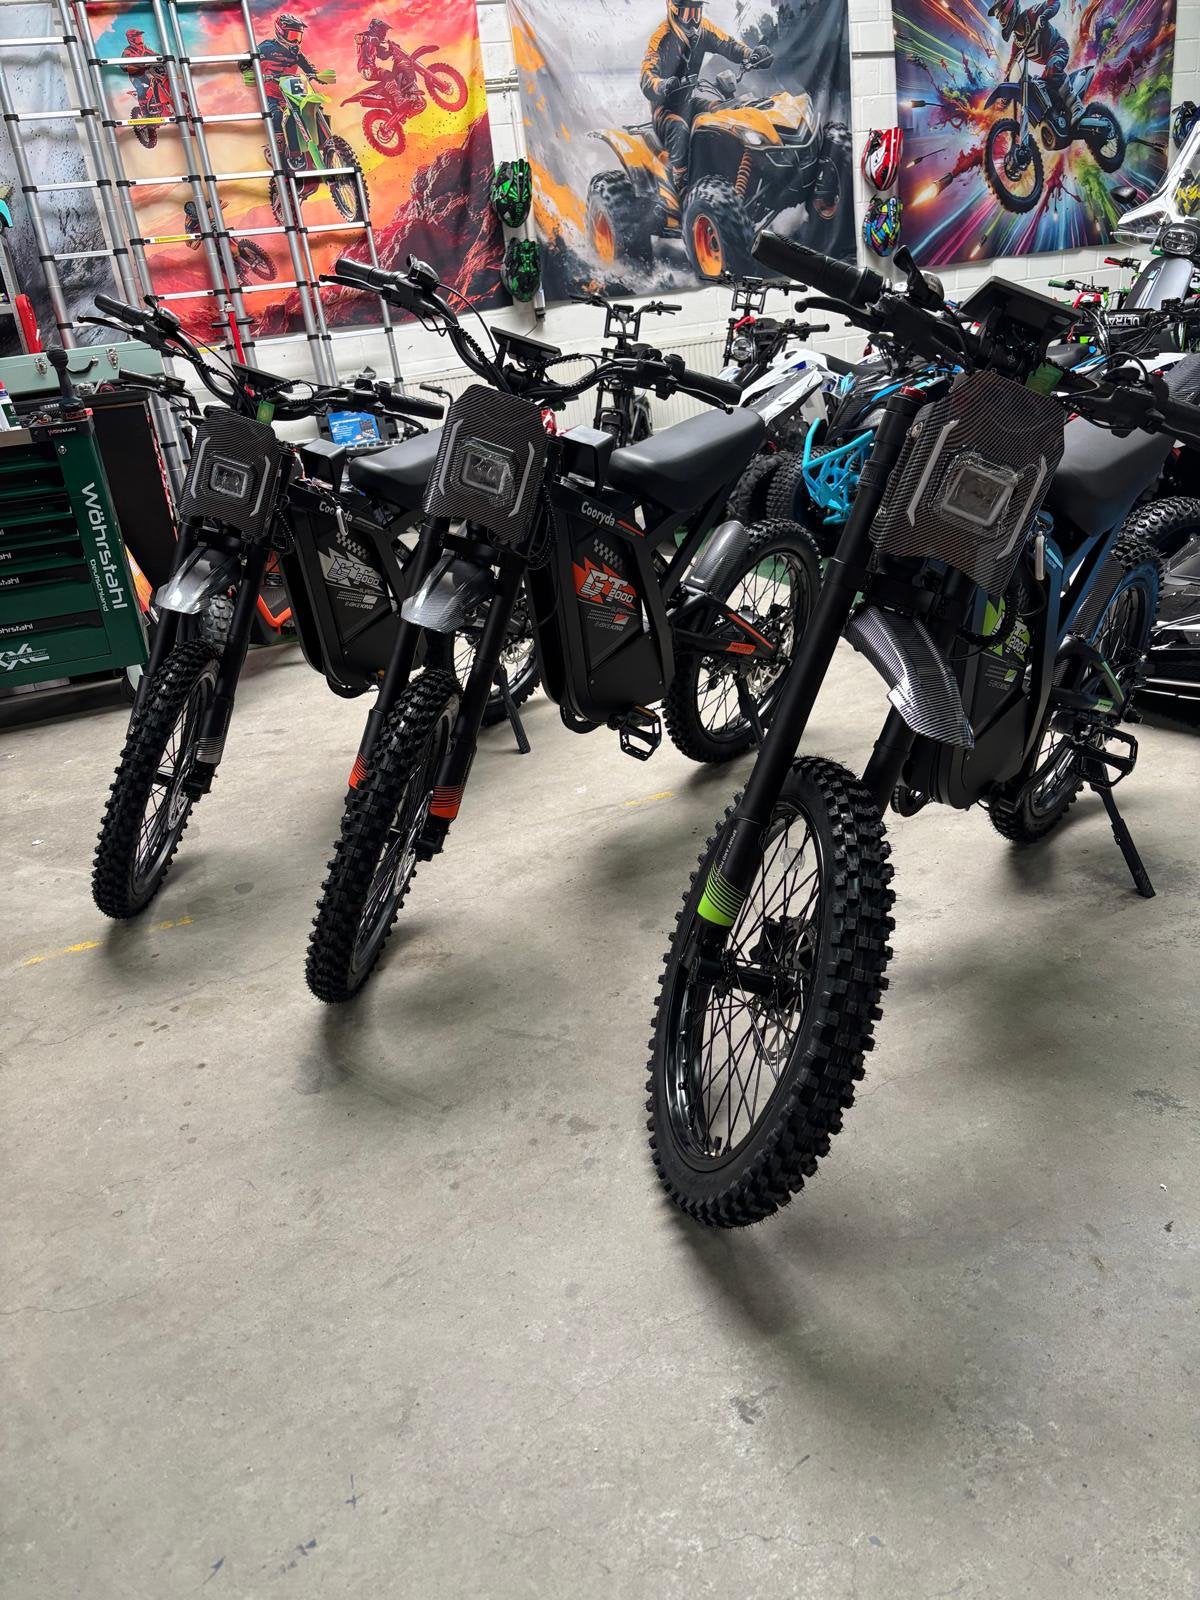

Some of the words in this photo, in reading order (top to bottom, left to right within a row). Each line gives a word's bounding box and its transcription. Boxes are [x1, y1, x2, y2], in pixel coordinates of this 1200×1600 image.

[1108, 316, 1140, 327] ULTRA
[319, 501, 353, 522] Cooda
[581, 501, 616, 526] Cooryda
[81, 482, 128, 609] Wöhrstahl
[89, 558, 109, 612] Deutschland
[354, 573, 380, 586] 2000
[580, 569, 629, 600] GT
[606, 587, 634, 603] 2000
[1006, 635, 1028, 655] 2000
[728, 830, 737, 848] SPORT
